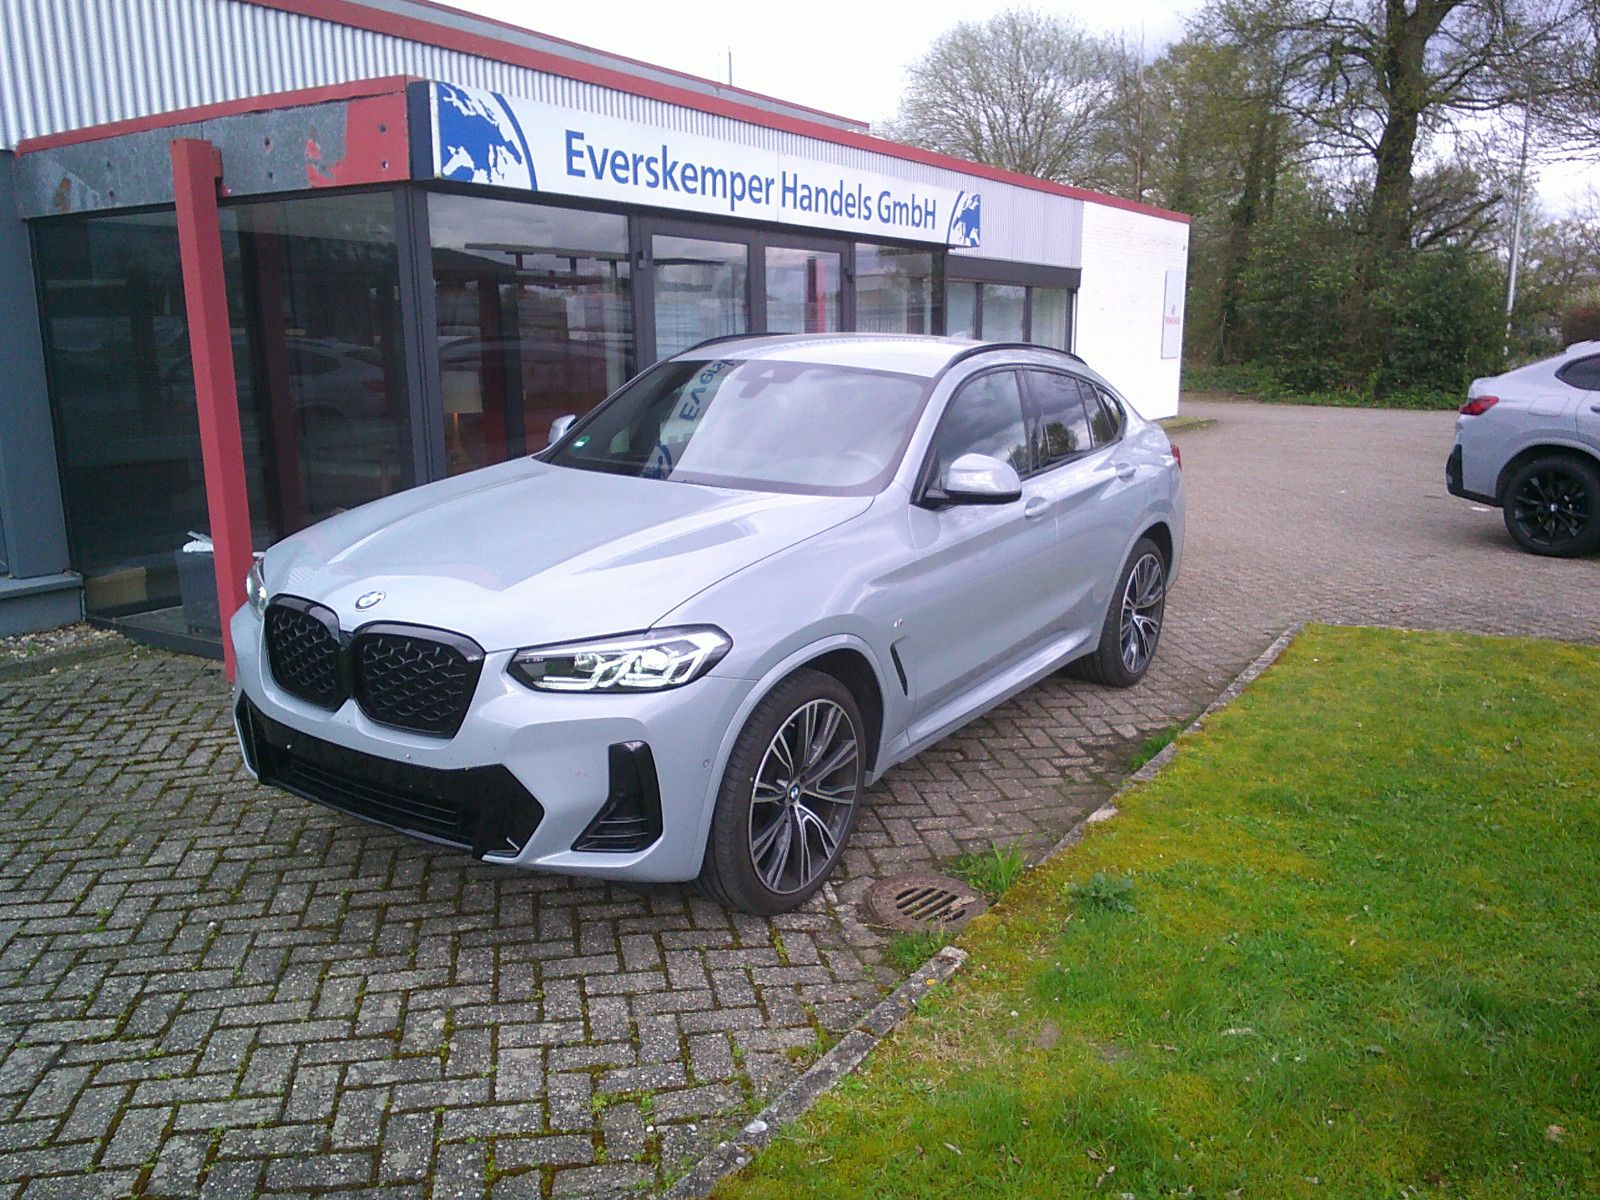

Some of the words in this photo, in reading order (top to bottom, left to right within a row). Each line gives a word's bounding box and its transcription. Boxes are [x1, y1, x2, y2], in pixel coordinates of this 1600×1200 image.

[565, 129, 775, 211] Everskemper
[781, 171, 872, 221] Handels
[876, 190, 937, 230] GmbH
